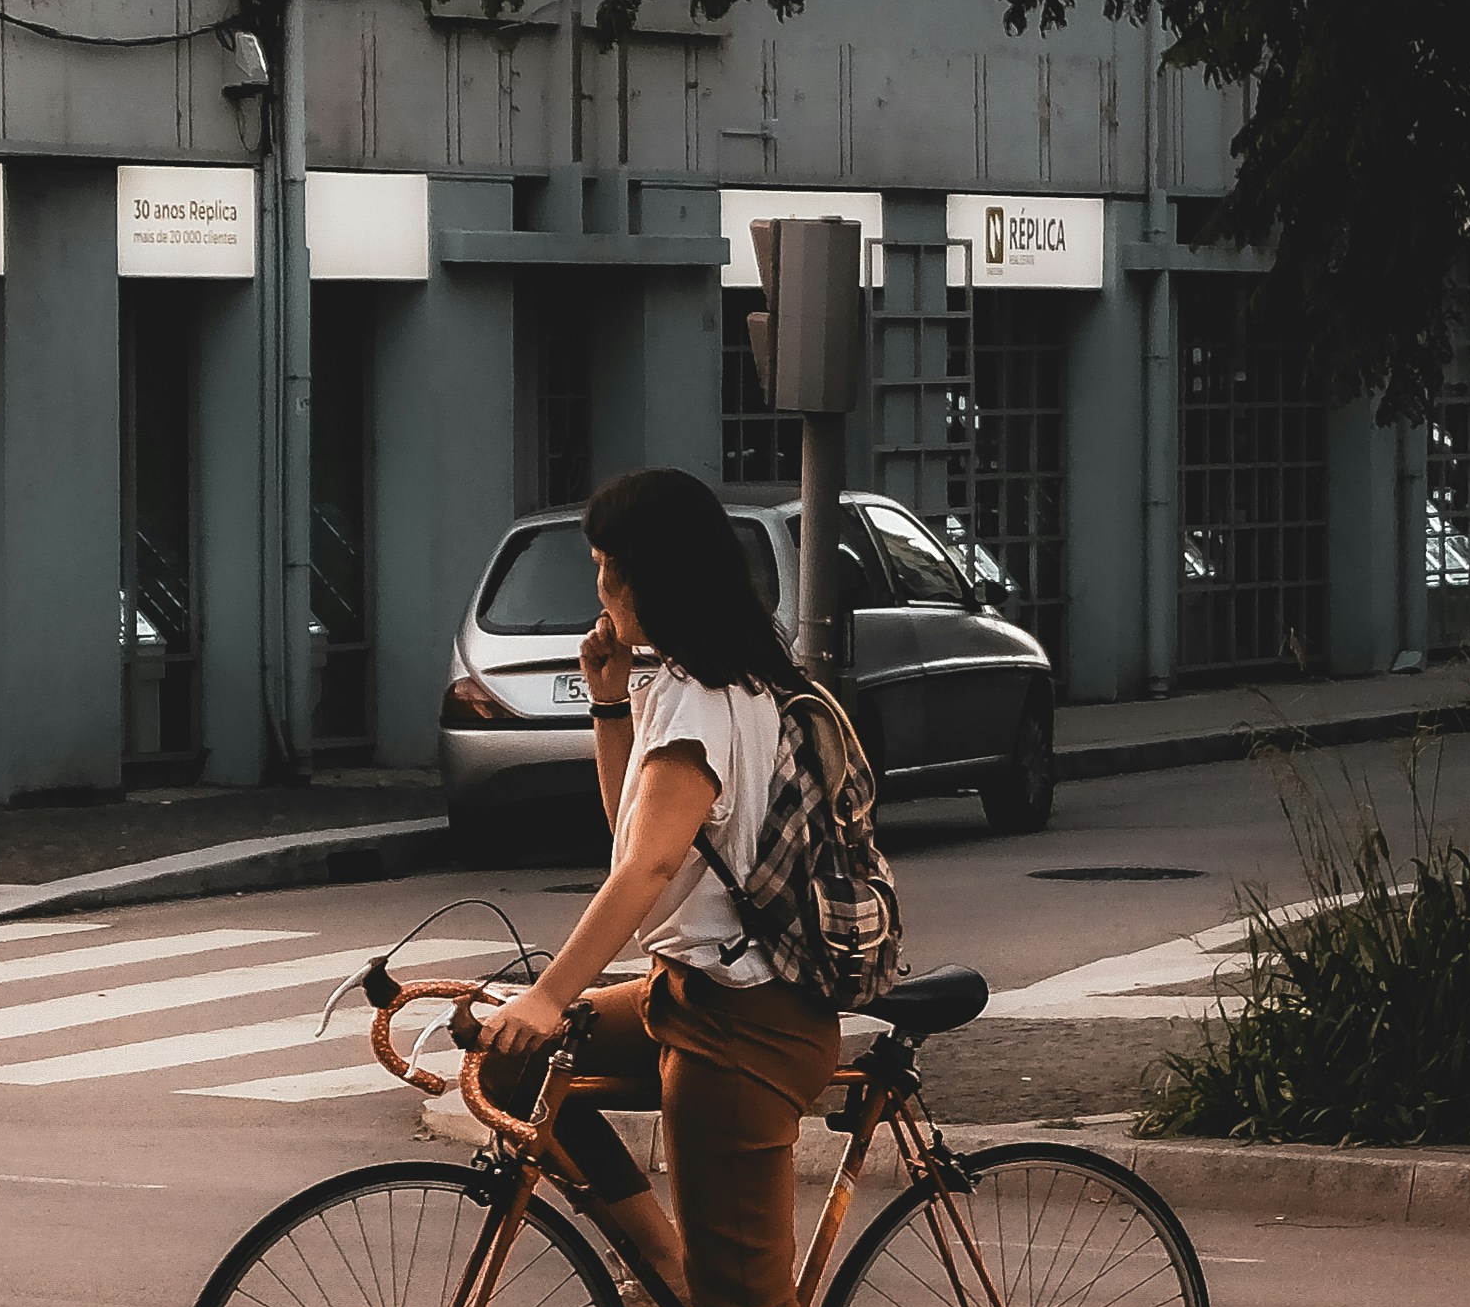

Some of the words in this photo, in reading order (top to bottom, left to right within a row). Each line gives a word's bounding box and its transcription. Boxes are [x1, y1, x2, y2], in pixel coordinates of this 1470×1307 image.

[133, 199, 150, 219] 30
[154, 203, 185, 220] anos
[189, 199, 238, 226] Réplica
[133, 229, 154, 243] mais
[156, 230, 167, 243] de
[1009, 207, 1067, 252] RÉPLICA
